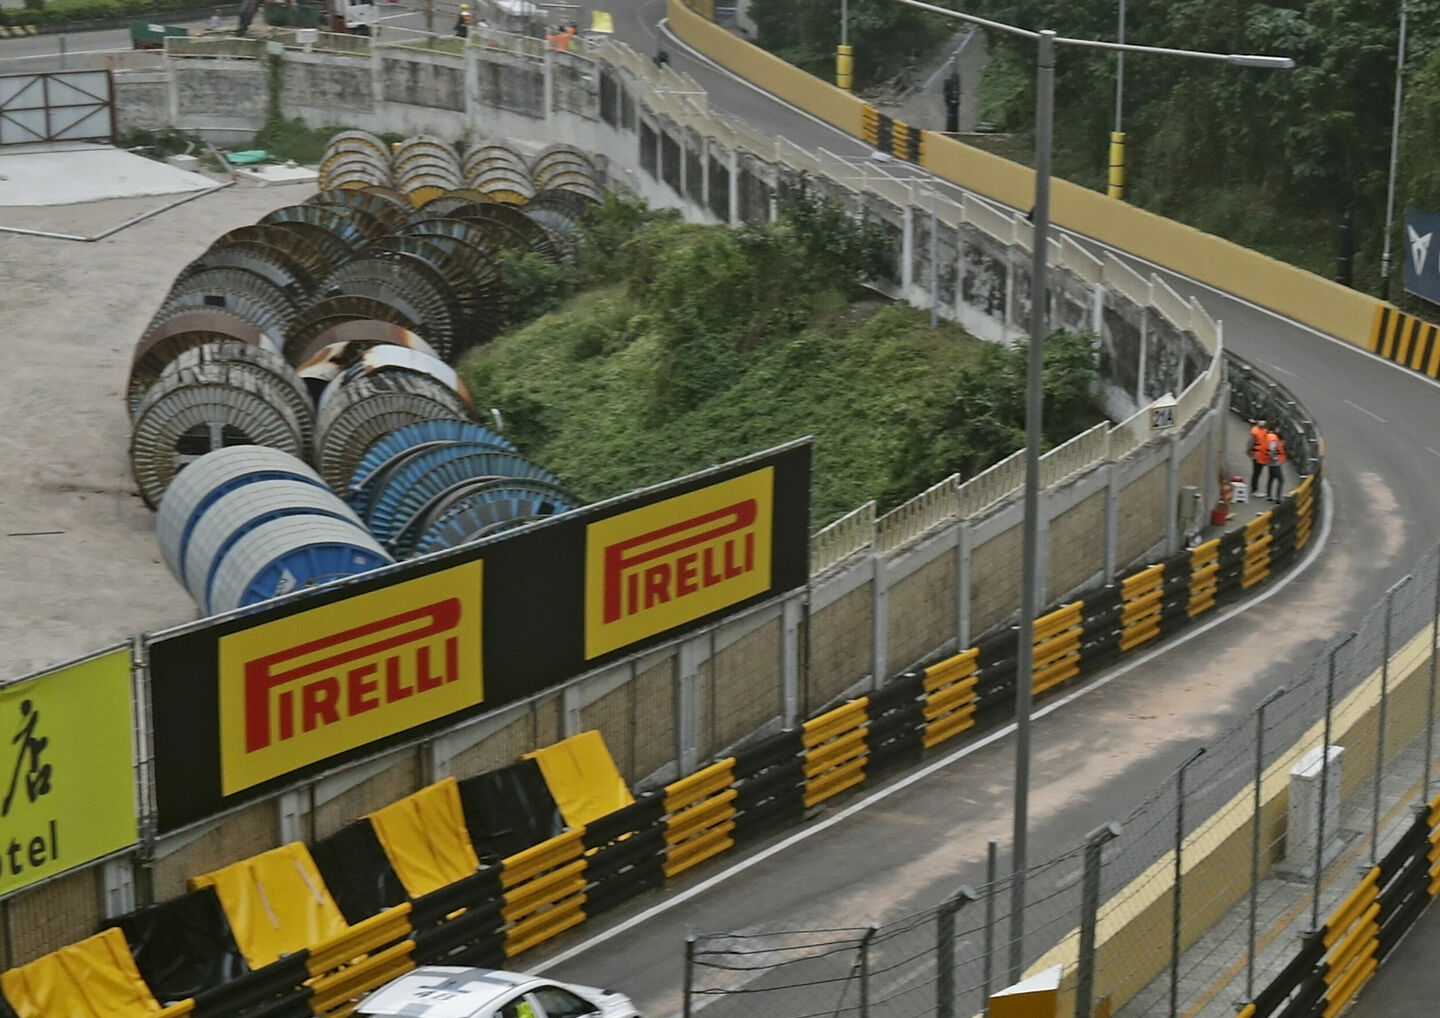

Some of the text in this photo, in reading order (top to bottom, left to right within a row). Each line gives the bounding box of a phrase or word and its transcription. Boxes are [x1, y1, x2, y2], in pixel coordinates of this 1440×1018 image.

[603, 498, 758, 626] PIRELLI
[244, 597, 462, 755] PIRELLI
[0, 819, 59, 881] tel
